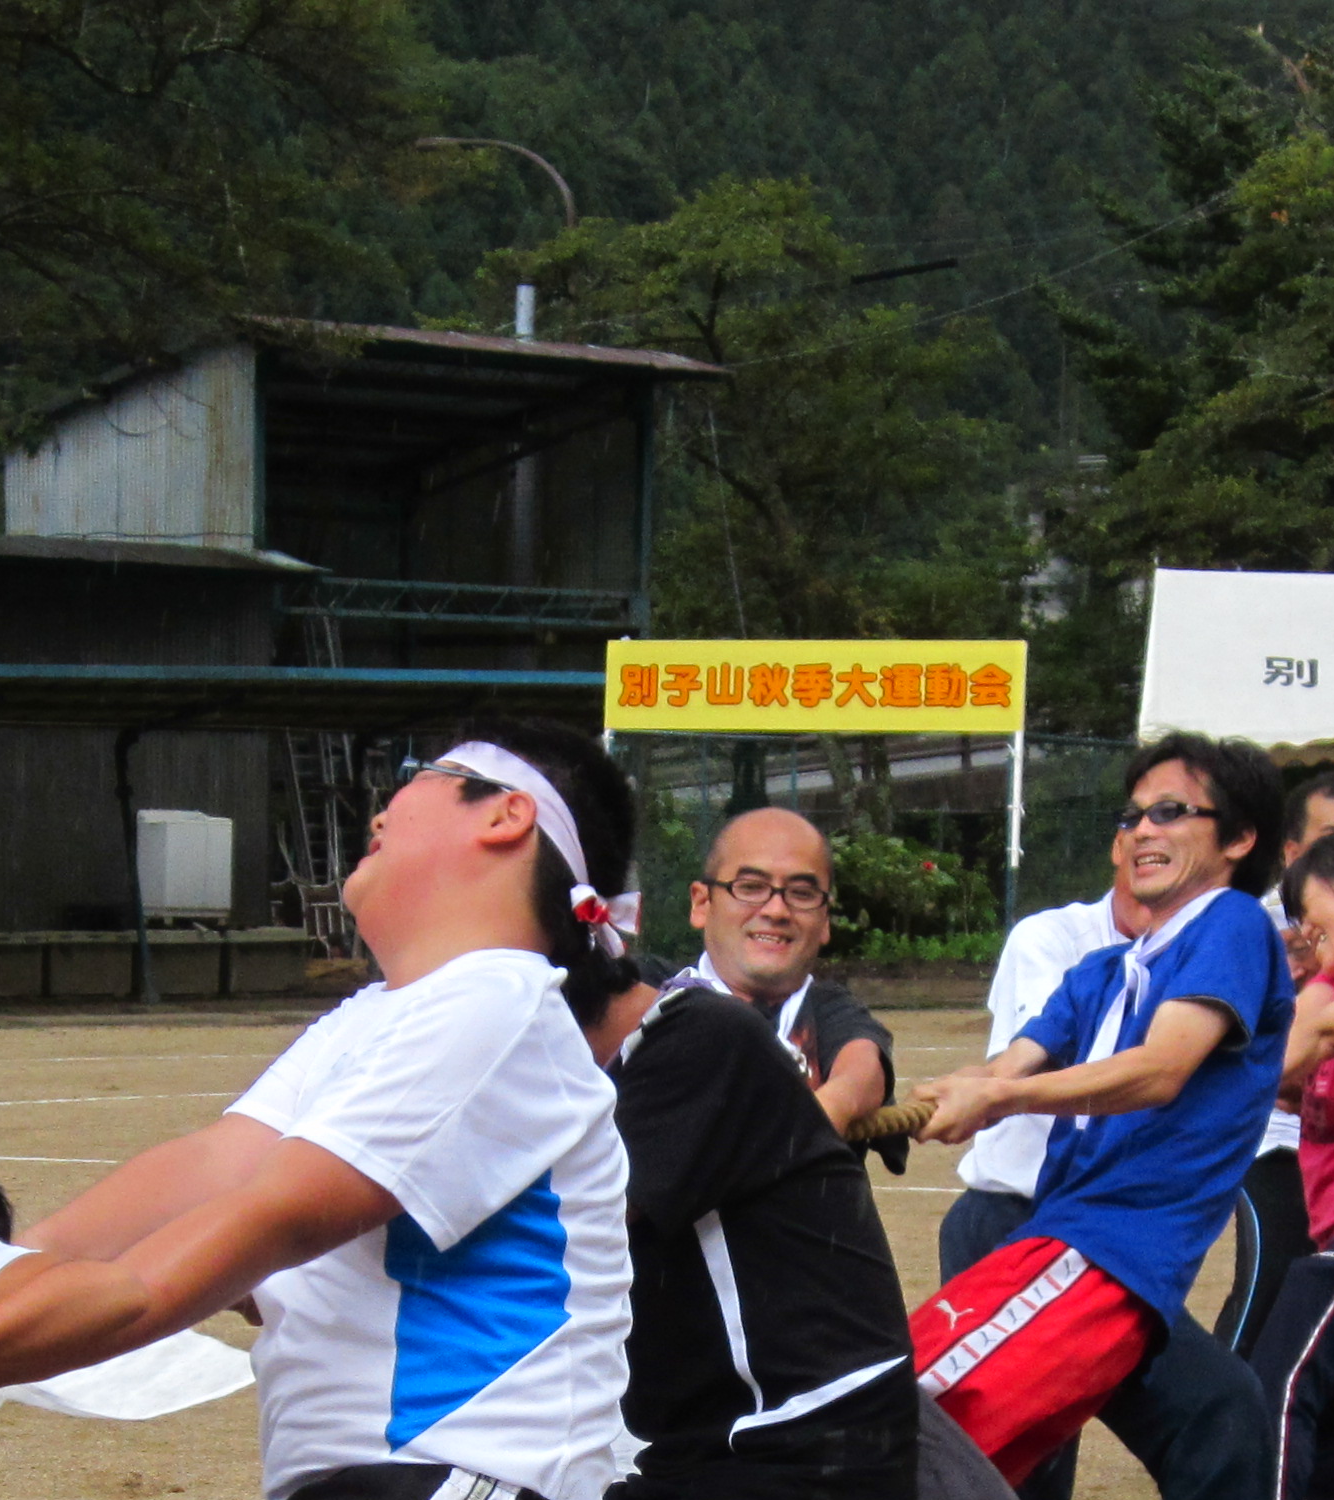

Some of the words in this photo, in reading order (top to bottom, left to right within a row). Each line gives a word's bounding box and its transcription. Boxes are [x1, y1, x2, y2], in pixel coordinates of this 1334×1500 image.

[618, 663, 1012, 707] 別子山秋季大運動会
